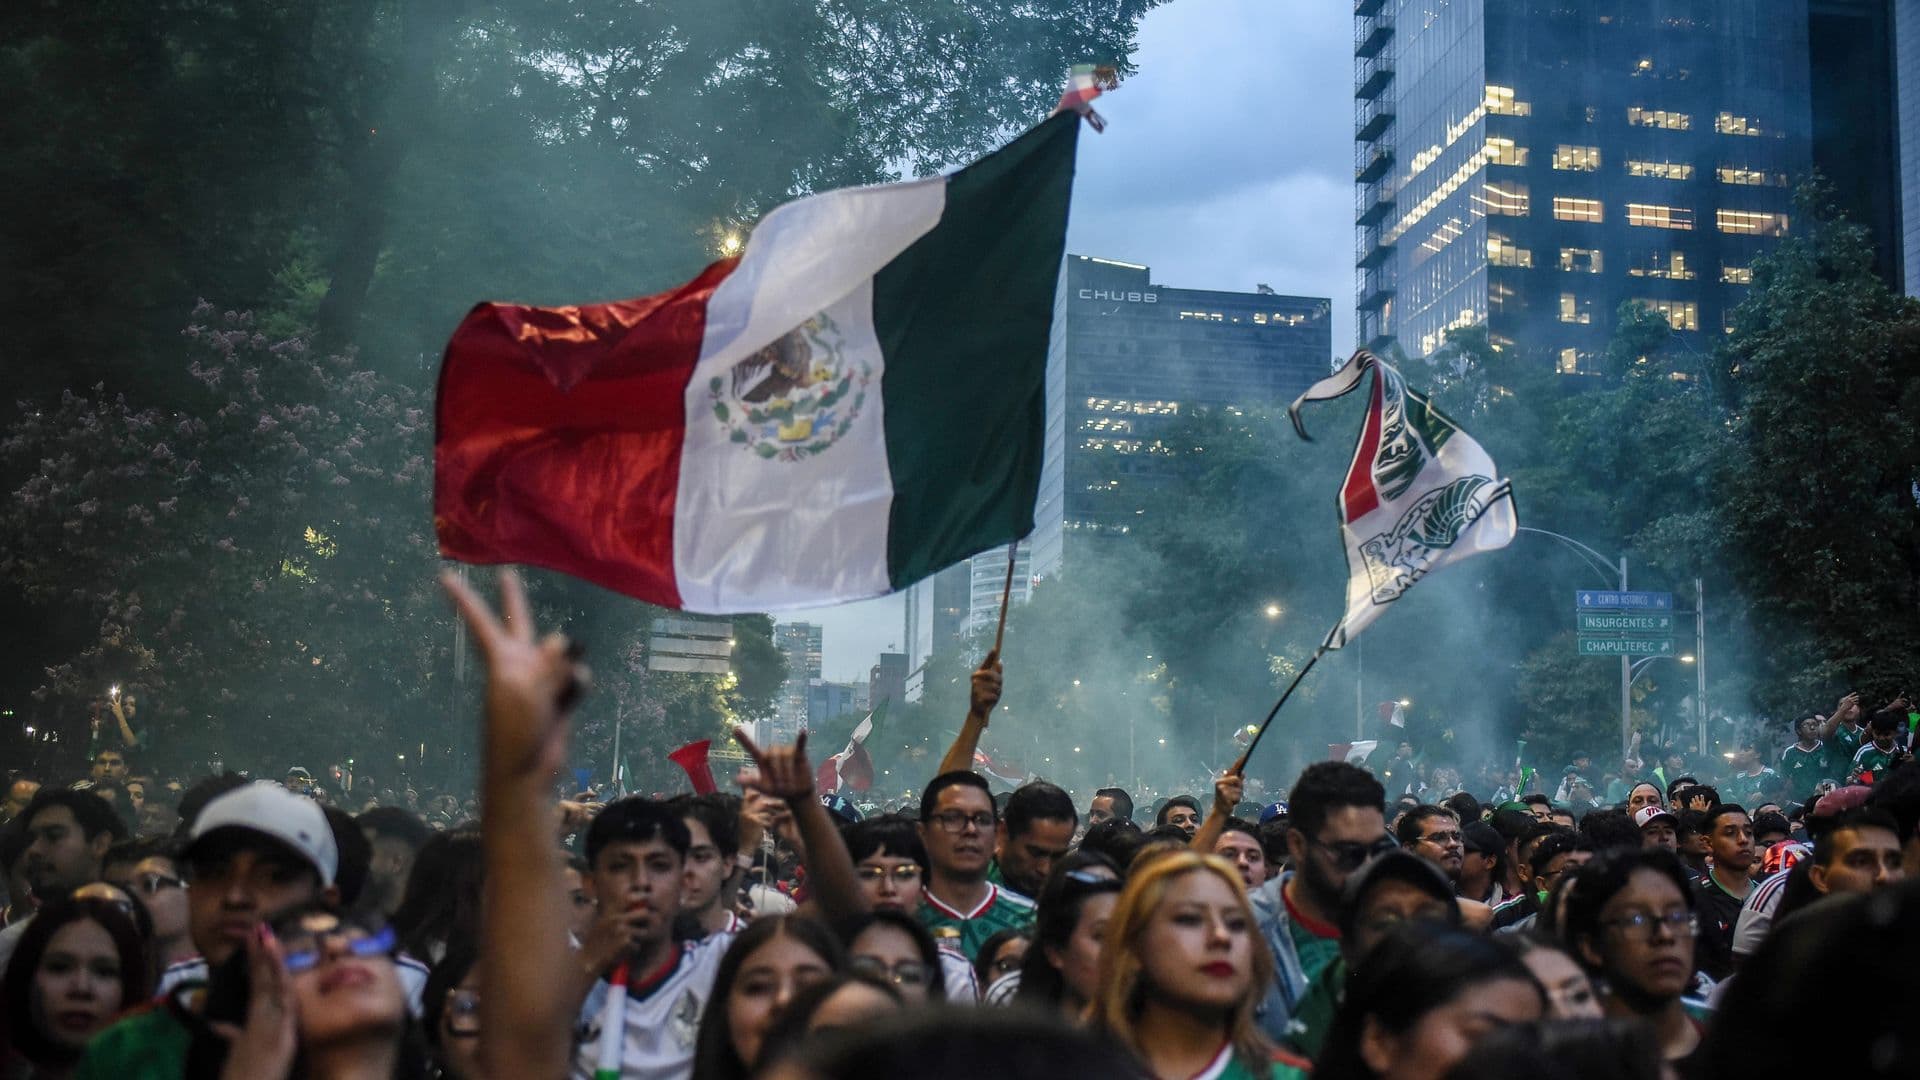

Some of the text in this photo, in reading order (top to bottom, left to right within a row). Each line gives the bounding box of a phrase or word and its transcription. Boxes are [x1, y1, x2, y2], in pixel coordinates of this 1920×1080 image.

[1079, 289, 1158, 303] CHUBB
[1585, 617, 1654, 628] INSURGENTES
[1586, 641, 1655, 652] CHAPULTEPEC
